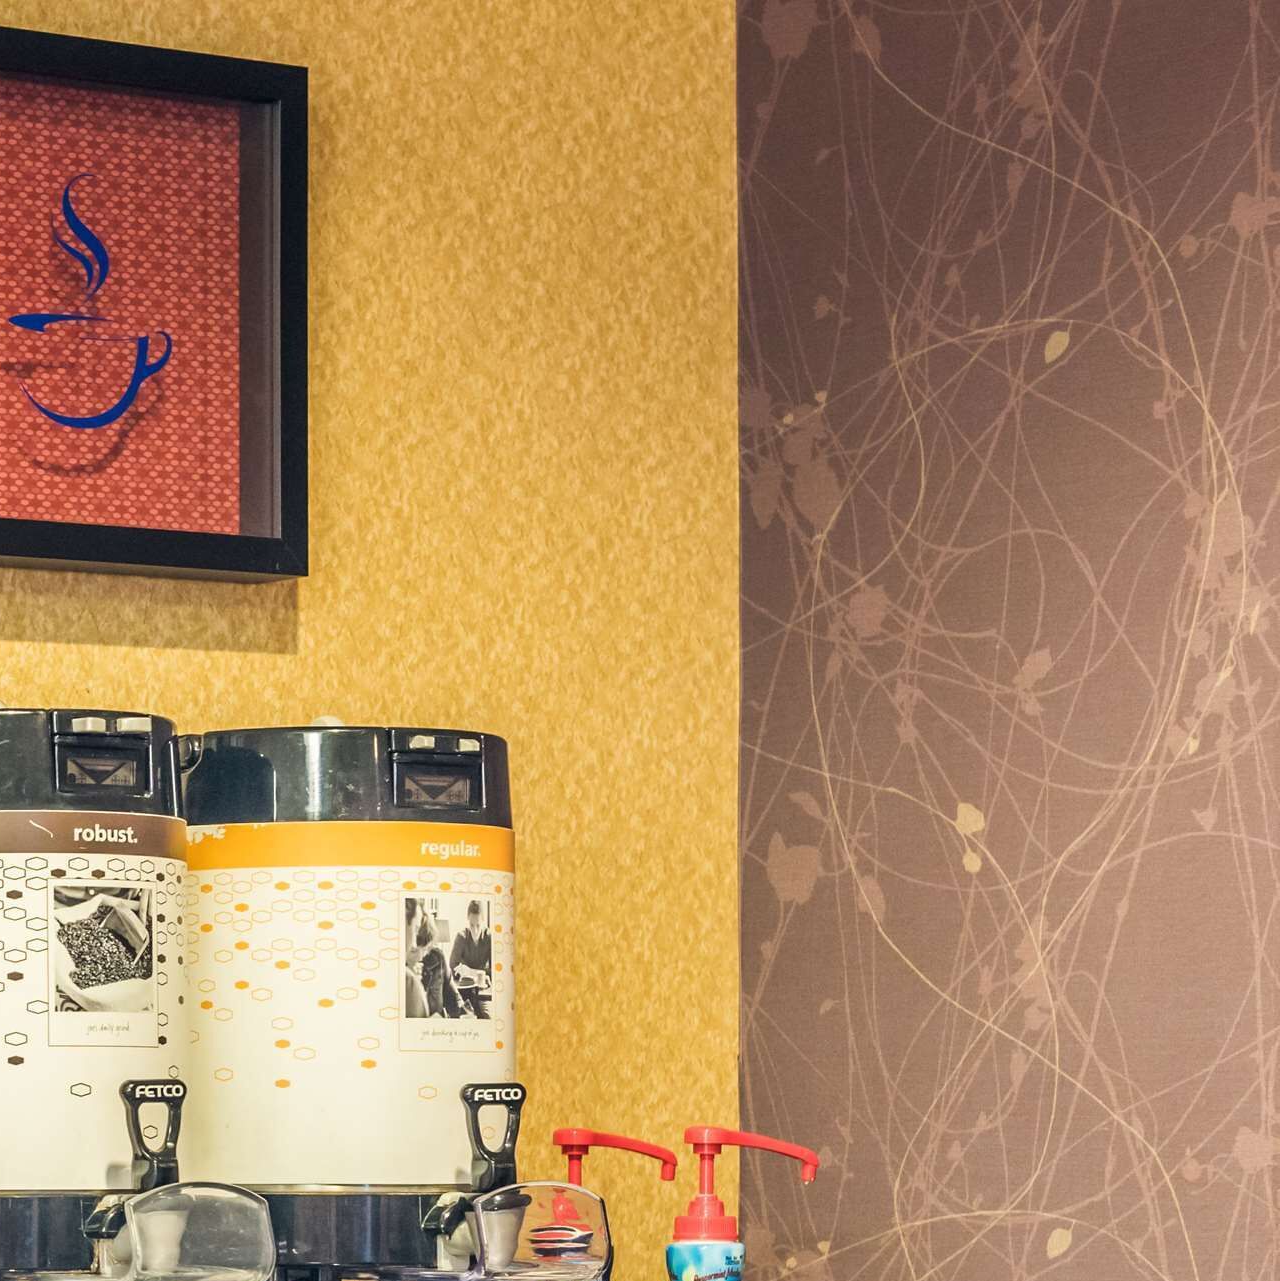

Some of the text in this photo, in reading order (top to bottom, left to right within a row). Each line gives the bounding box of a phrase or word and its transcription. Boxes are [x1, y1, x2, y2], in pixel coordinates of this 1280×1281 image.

[73, 823, 138, 843] robust.
[420, 839, 481, 861] regular.
[135, 1084, 184, 1098] FETCO
[474, 1087, 522, 1101] FETCO
